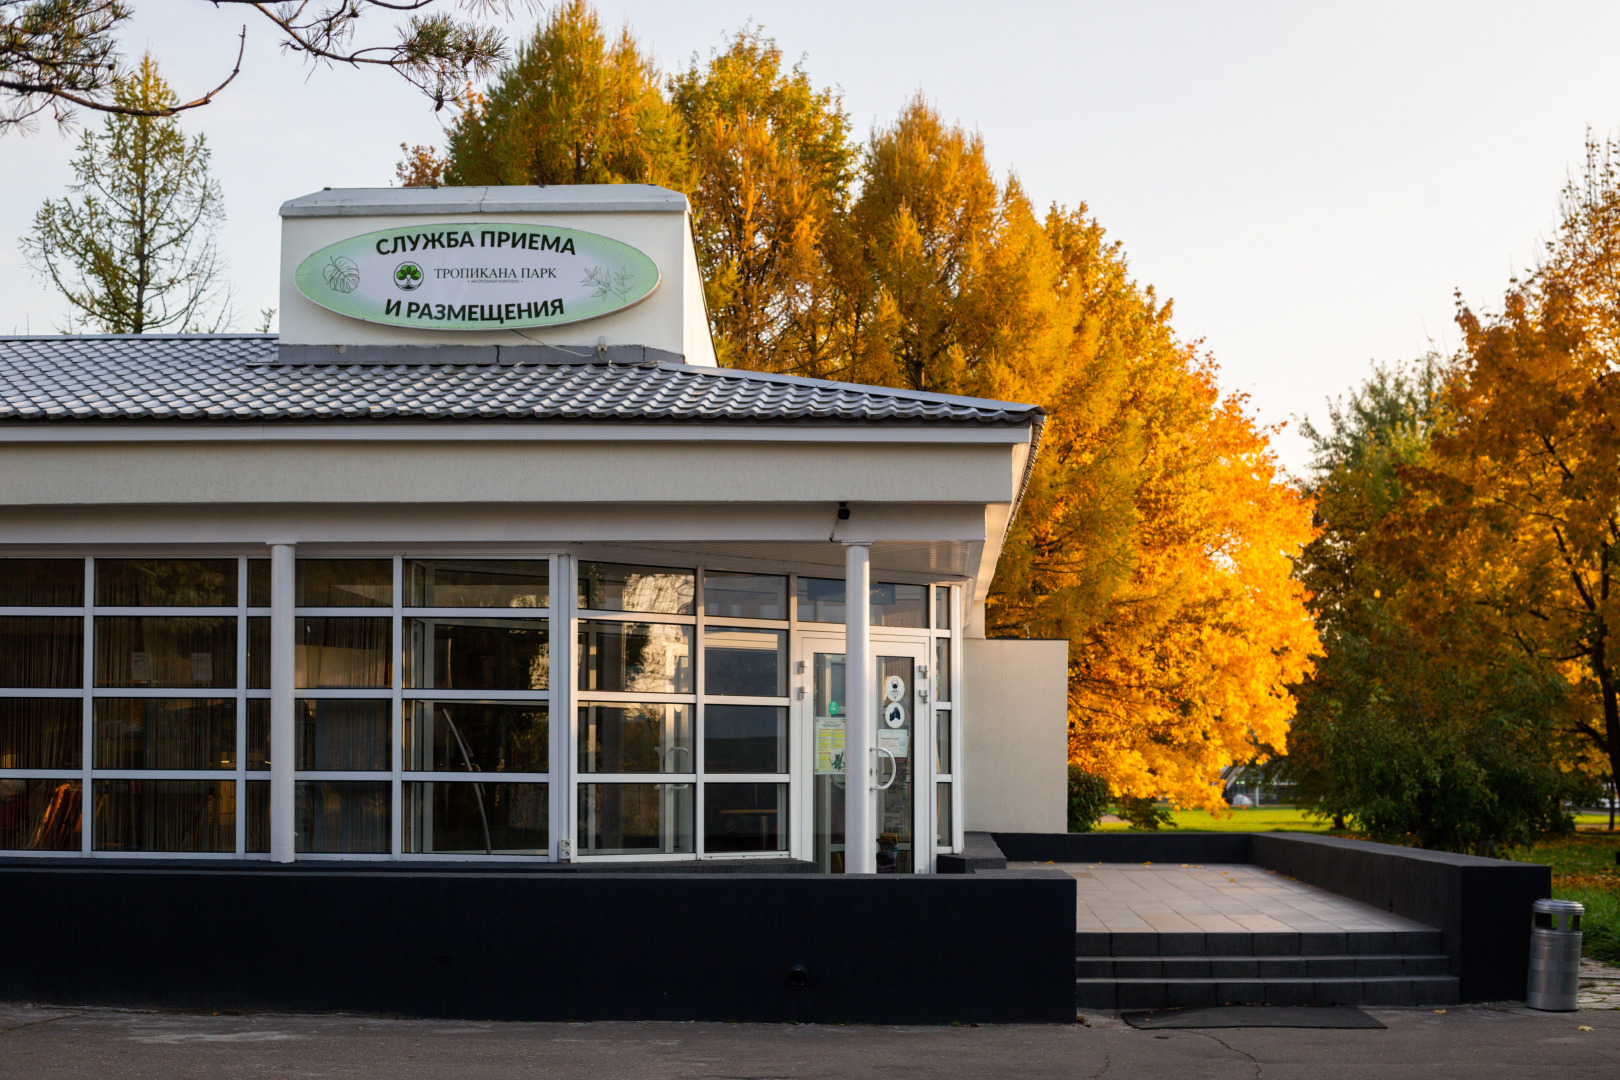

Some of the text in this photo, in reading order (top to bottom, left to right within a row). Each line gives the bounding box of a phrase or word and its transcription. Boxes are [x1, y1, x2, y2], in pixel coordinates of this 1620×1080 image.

[376, 230, 576, 255] СЛУЖБА ПРИЕМА
[434, 267, 557, 279] ТРОПИКАНА ПАРК
[384, 298, 565, 324] И РАЗМЕЩЕНИЯ
